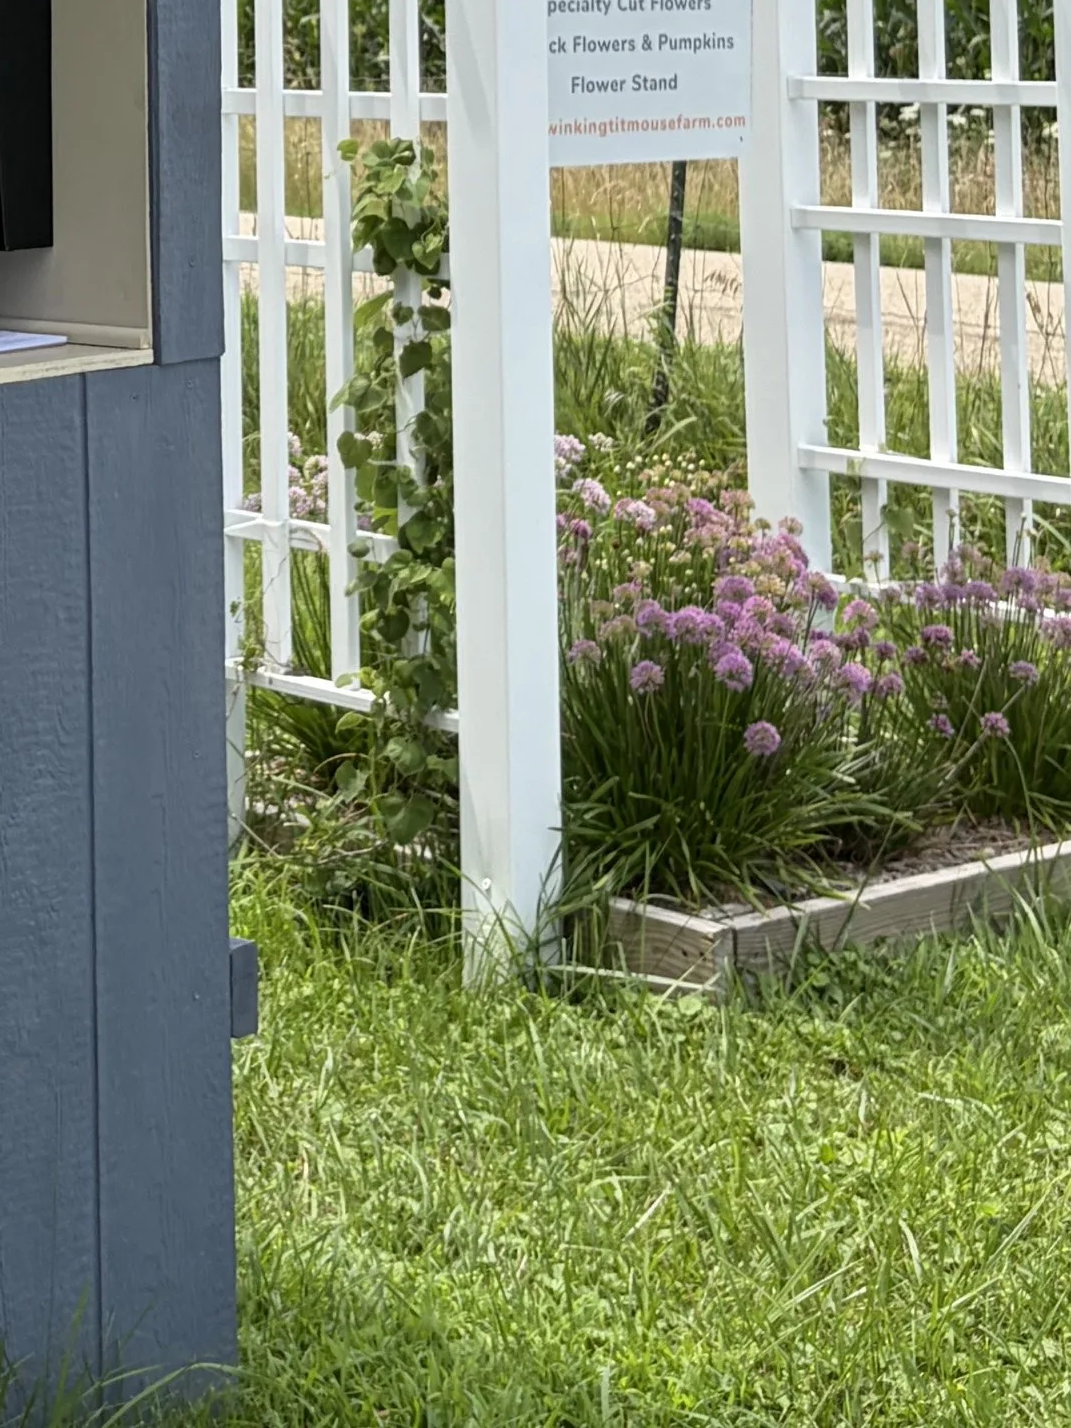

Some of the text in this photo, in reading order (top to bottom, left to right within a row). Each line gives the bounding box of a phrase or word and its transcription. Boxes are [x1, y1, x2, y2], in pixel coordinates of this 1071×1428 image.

[572, 35, 636, 54] Flowers
[641, 33, 653, 52] &
[657, 31, 735, 54] Pumpkins
[570, 73, 678, 94] Flower Stand
